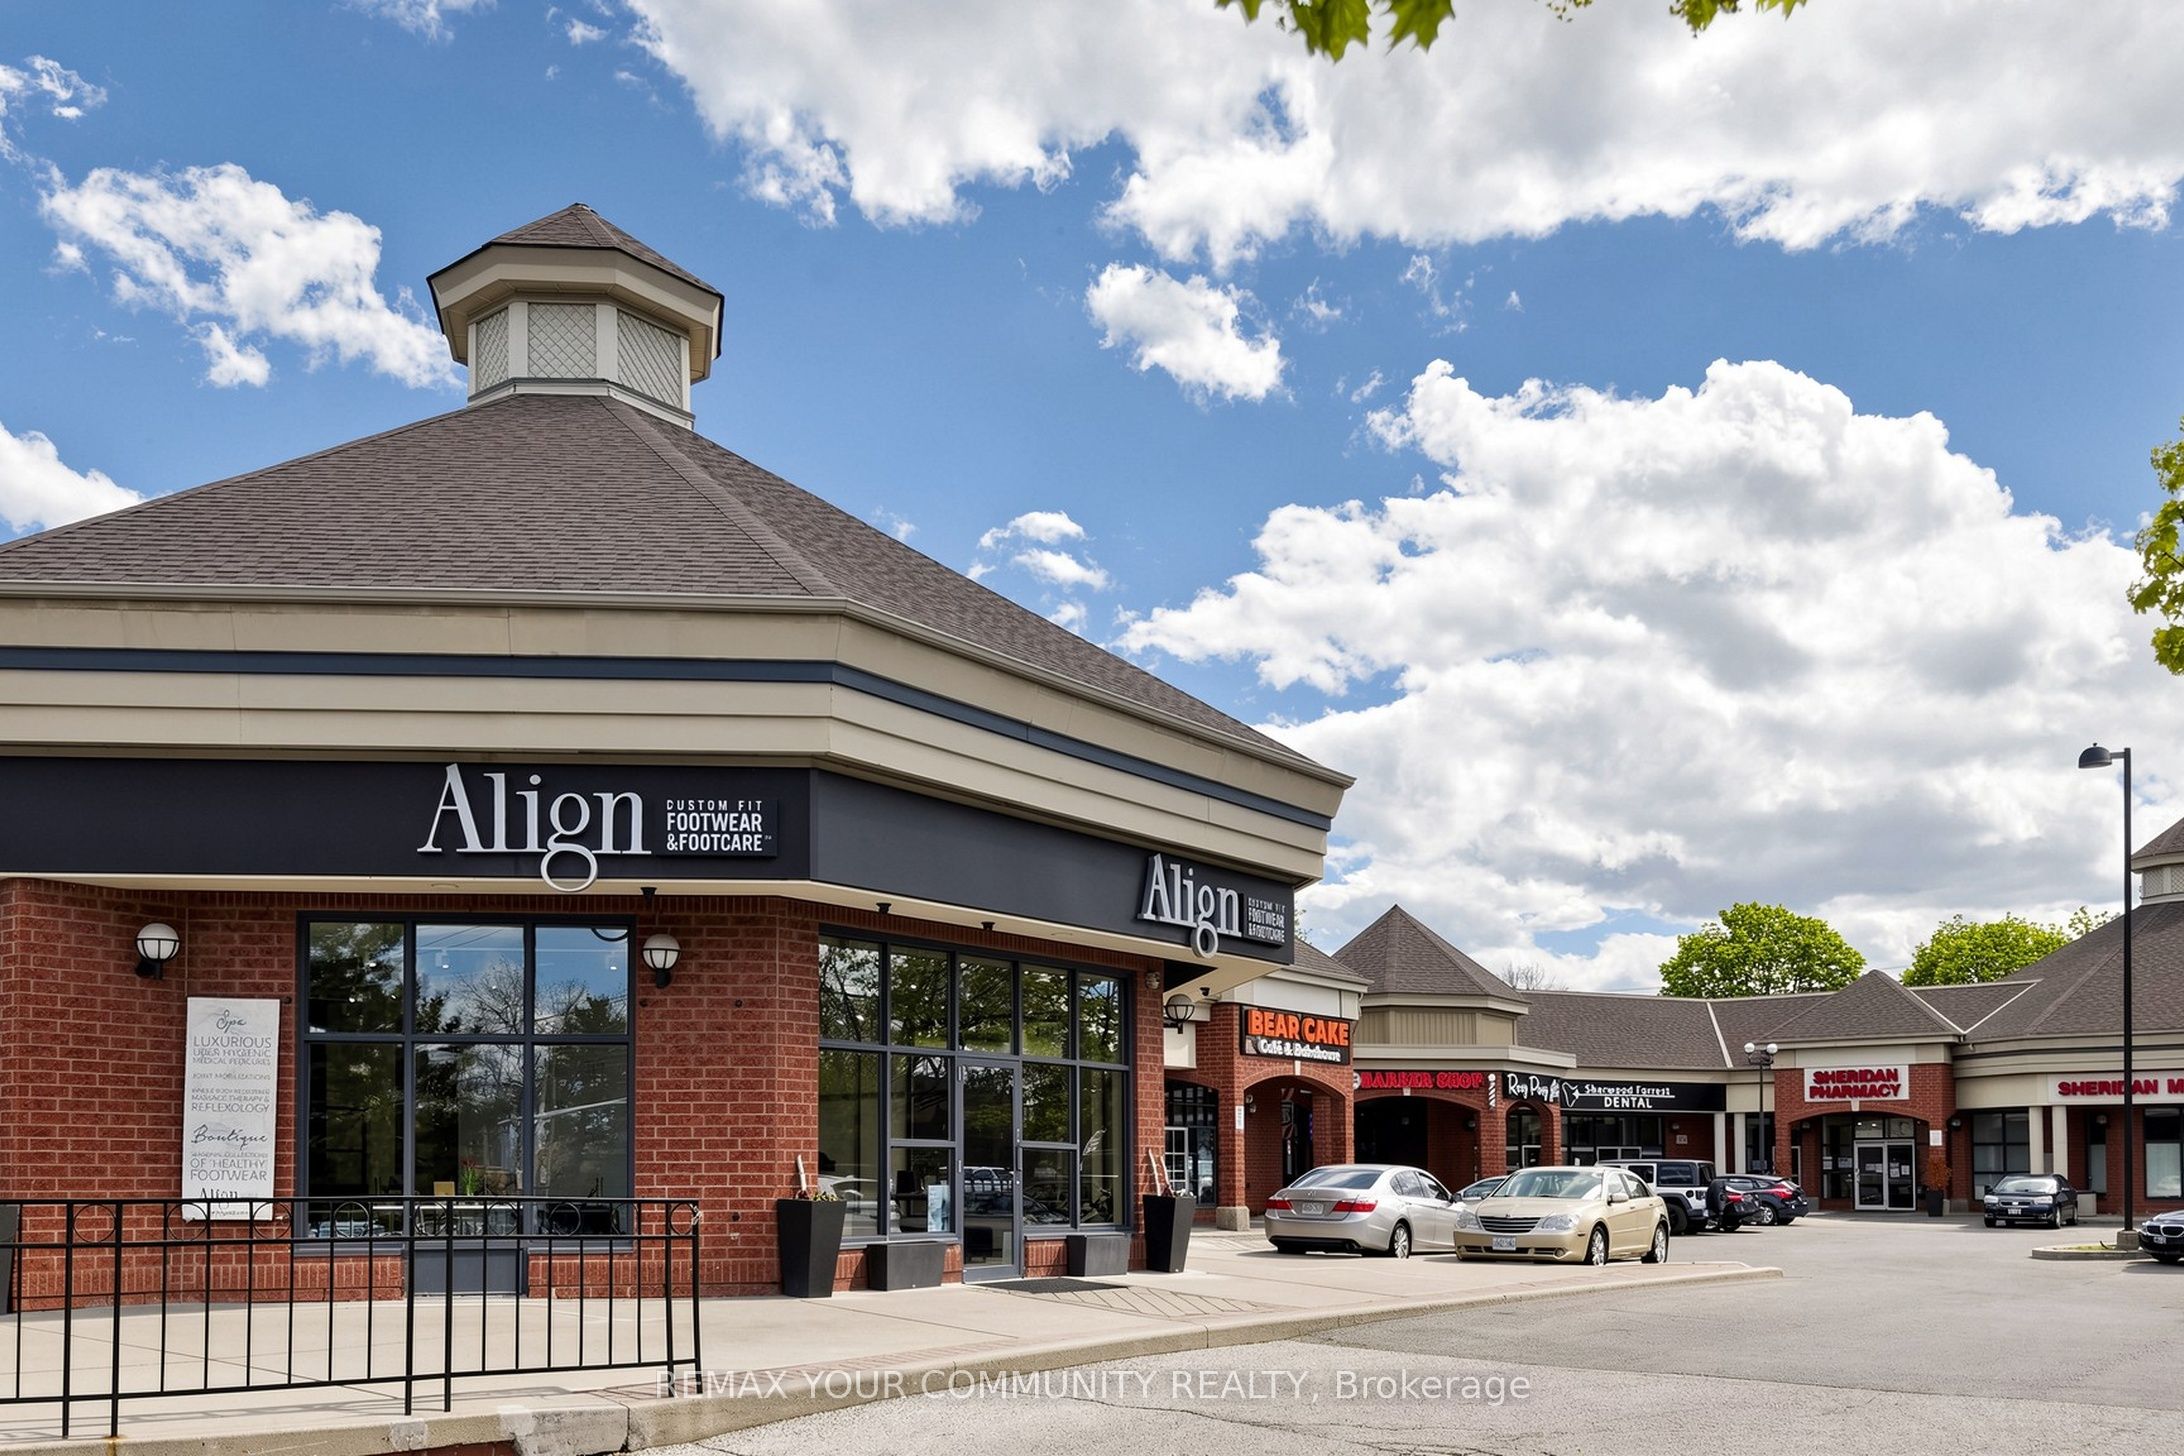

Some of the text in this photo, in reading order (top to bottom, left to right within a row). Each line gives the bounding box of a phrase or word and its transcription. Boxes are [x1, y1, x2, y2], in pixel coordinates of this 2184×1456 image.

[738, 801, 762, 811] FIT
[417, 763, 651, 892] Align
[666, 812, 762, 832] FOOTWEAR
[666, 833, 763, 851] &FOOTCARE
[1143, 853, 1242, 959] Align
[1248, 1009, 1349, 1046] BEAR CAKE
[193, 1036, 272, 1049] LUXURIOUS
[1436, 1071, 1483, 1089] SHOP
[1813, 1068, 1899, 1085] SHERIDAN
[1809, 1084, 1901, 1099] PHARMACY
[2058, 1079, 2159, 1096] SHERIDAN
[191, 1103, 270, 1113] REFLEXOLOGY
[1604, 1097, 1653, 1109] DENTAL
[191, 1124, 269, 1151] Boutique
[190, 1158, 266, 1168] OF HEALTHY
[190, 1169, 267, 1181] FOOTWEAR
